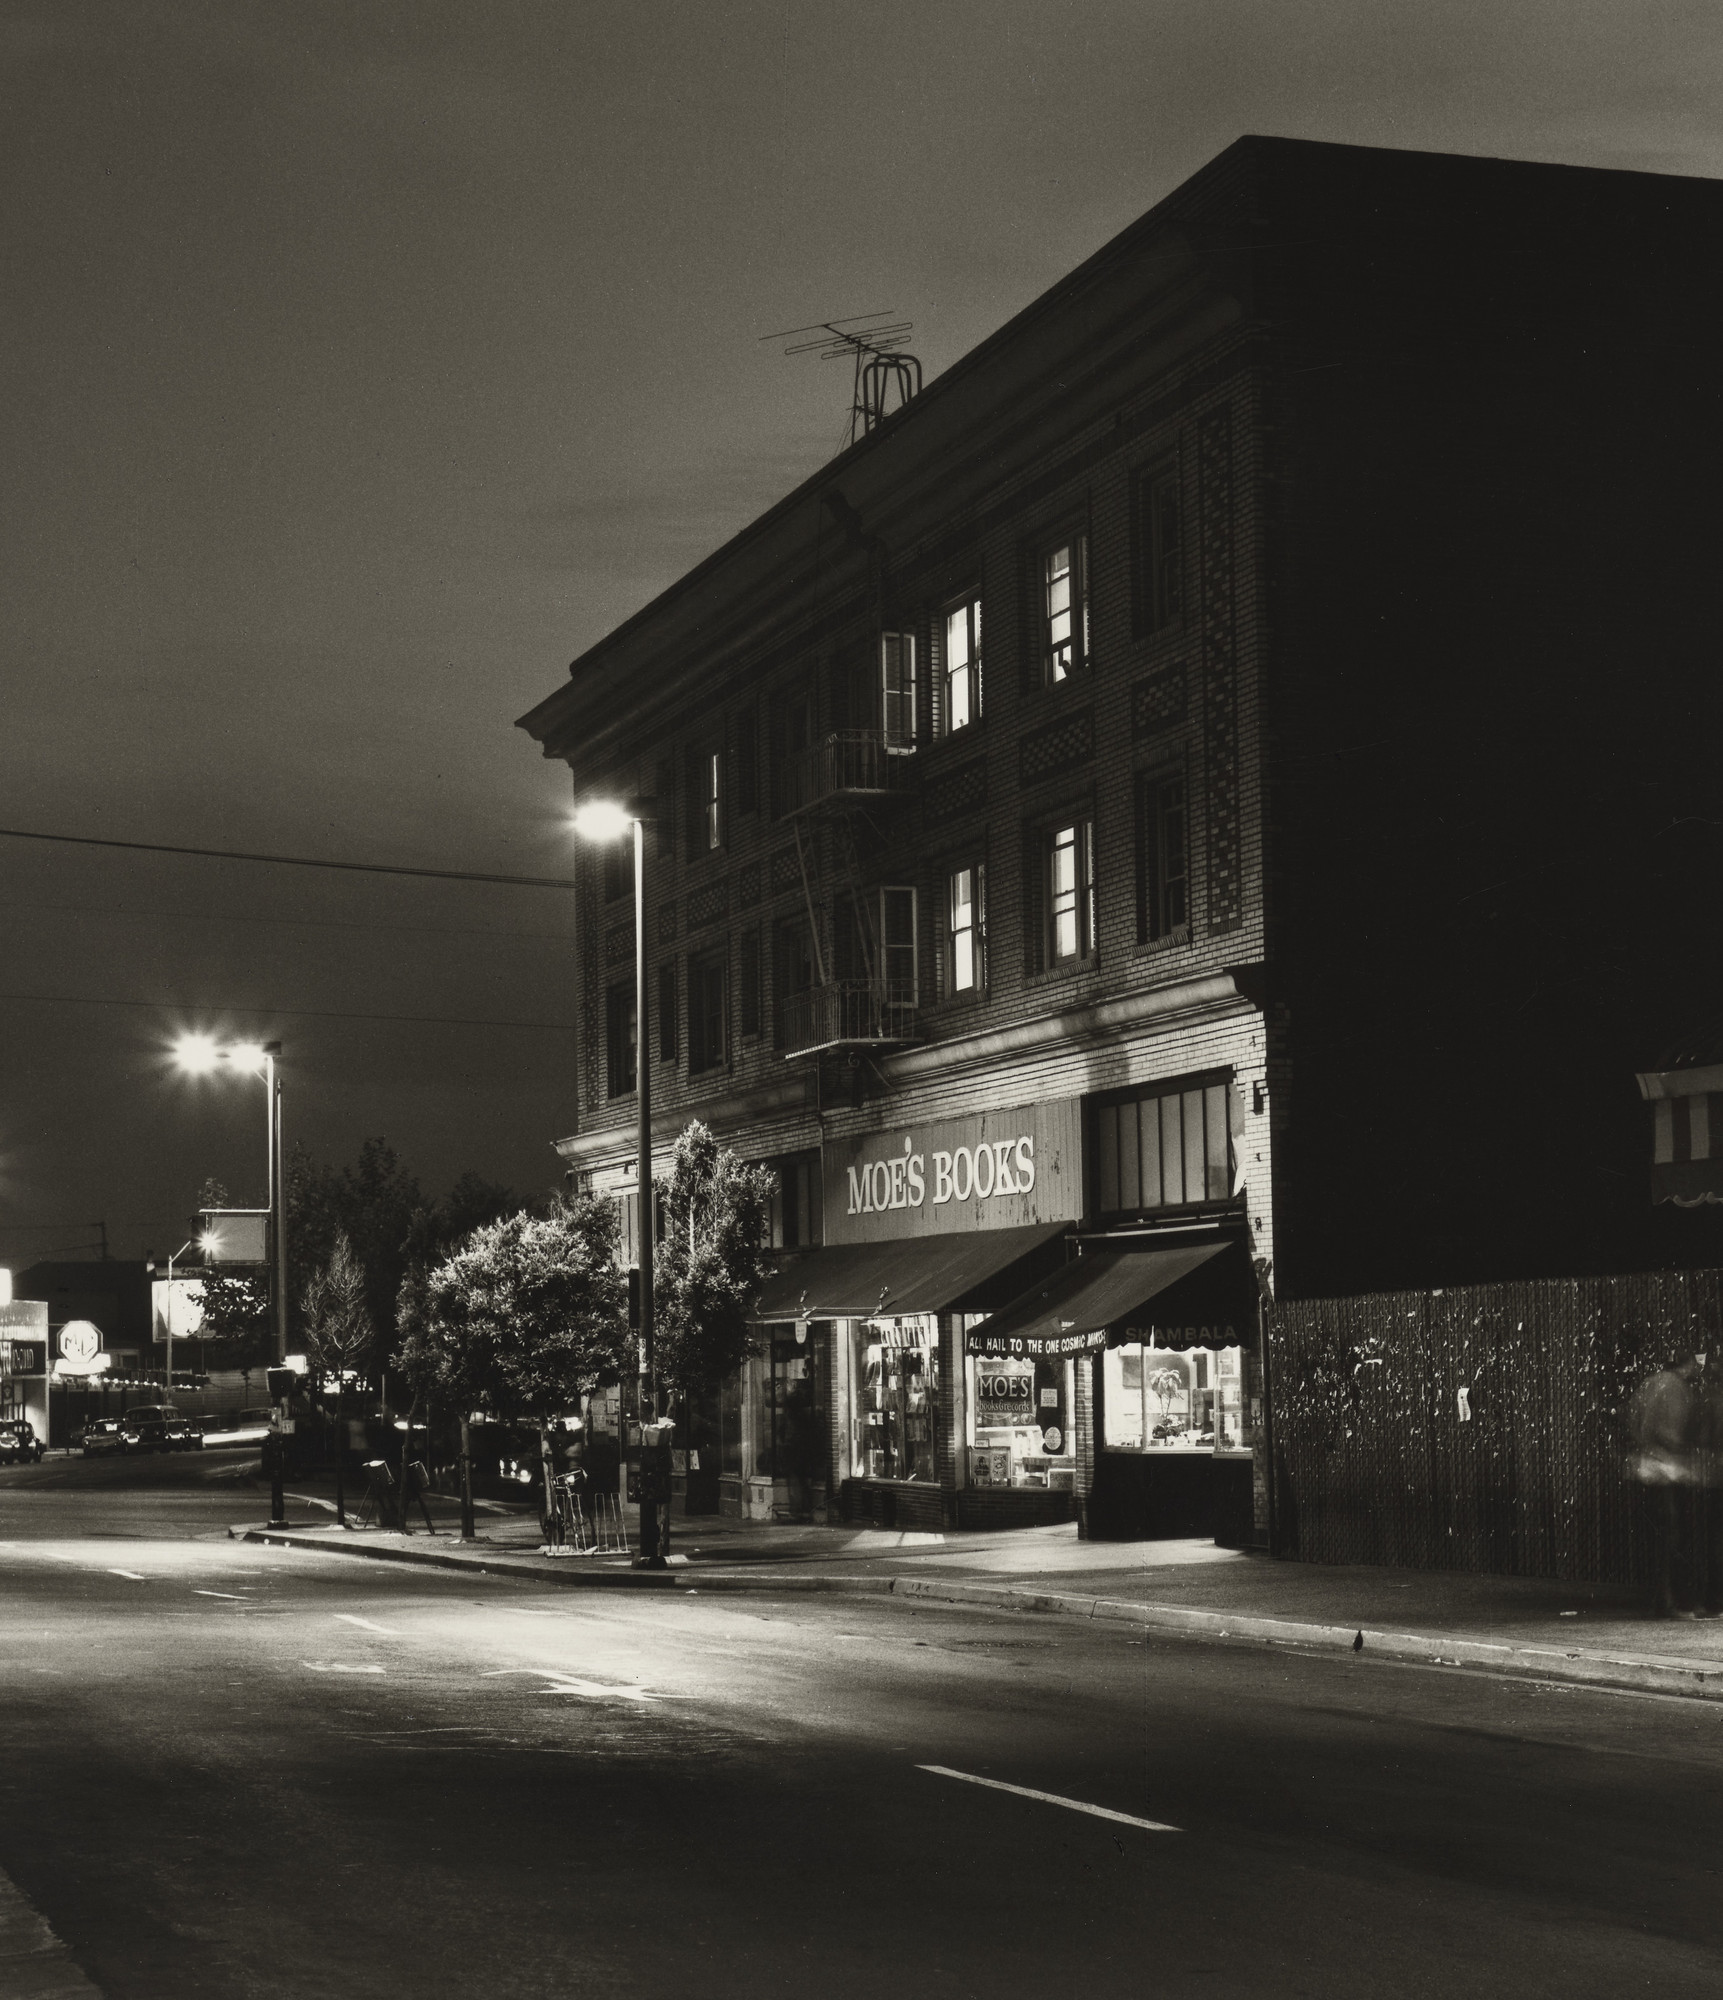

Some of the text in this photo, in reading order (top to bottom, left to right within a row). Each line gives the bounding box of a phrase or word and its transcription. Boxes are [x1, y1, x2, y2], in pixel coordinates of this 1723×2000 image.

[847, 1135, 1035, 1215] MOE'S BOOKS
[1125, 1325, 1238, 1342] SHAMBALA
[969, 1337, 983, 1349] ALL
[986, 1337, 1006, 1351] HAIL
[1010, 1338, 1023, 1352] TO
[1027, 1339, 1043, 1353] THE
[1045, 1339, 1060, 1354] ONE
[1061, 1334, 1086, 1352] COSMIC
[979, 1376, 1029, 1397] MOE'S
